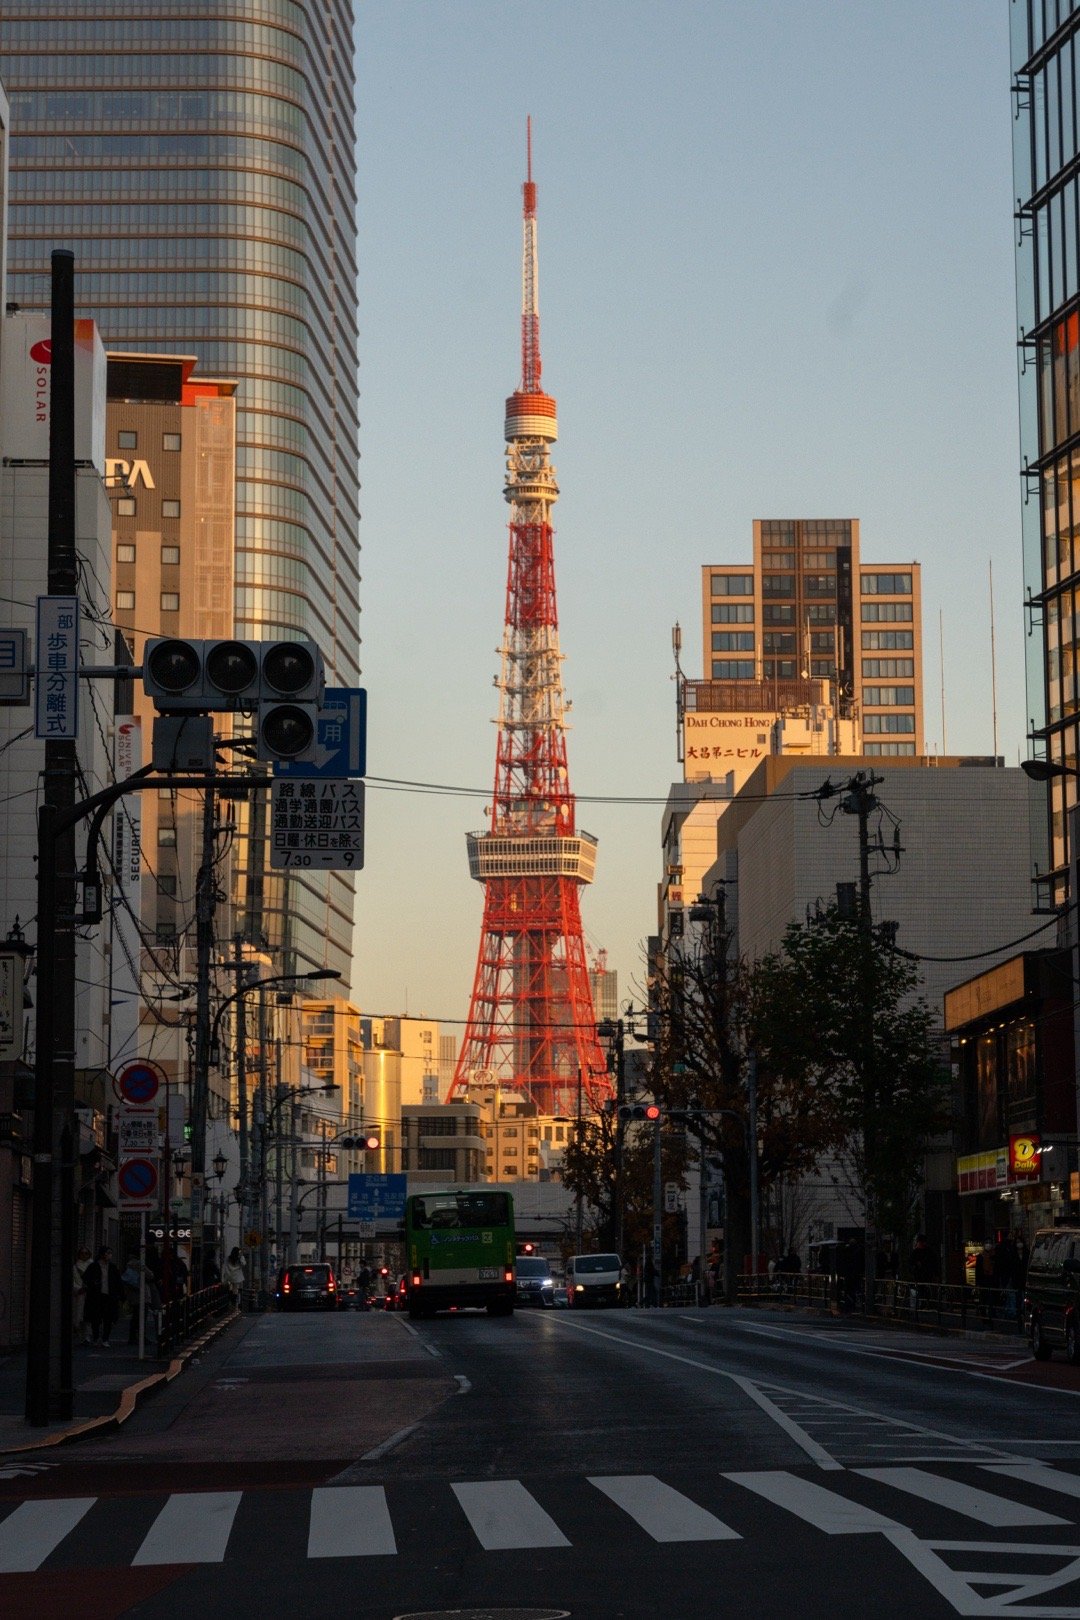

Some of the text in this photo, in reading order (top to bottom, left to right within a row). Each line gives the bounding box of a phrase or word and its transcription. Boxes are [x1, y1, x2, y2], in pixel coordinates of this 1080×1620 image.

[35, 366, 47, 423] SOLAR
[105, 458, 156, 489] PA
[57, 605, 75, 630] 一部
[46, 632, 68, 734] 歩車分離式
[323, 723, 342, 743] 用
[279, 782, 357, 798] 路線バス
[274, 799, 361, 814] 通学通園バス
[274, 814, 361, 829] 通勤送迎バス
[131, 817, 141, 882] SECURITY
[343, 851, 355, 867] 9
[1014, 1161, 1037, 1172] Daily
